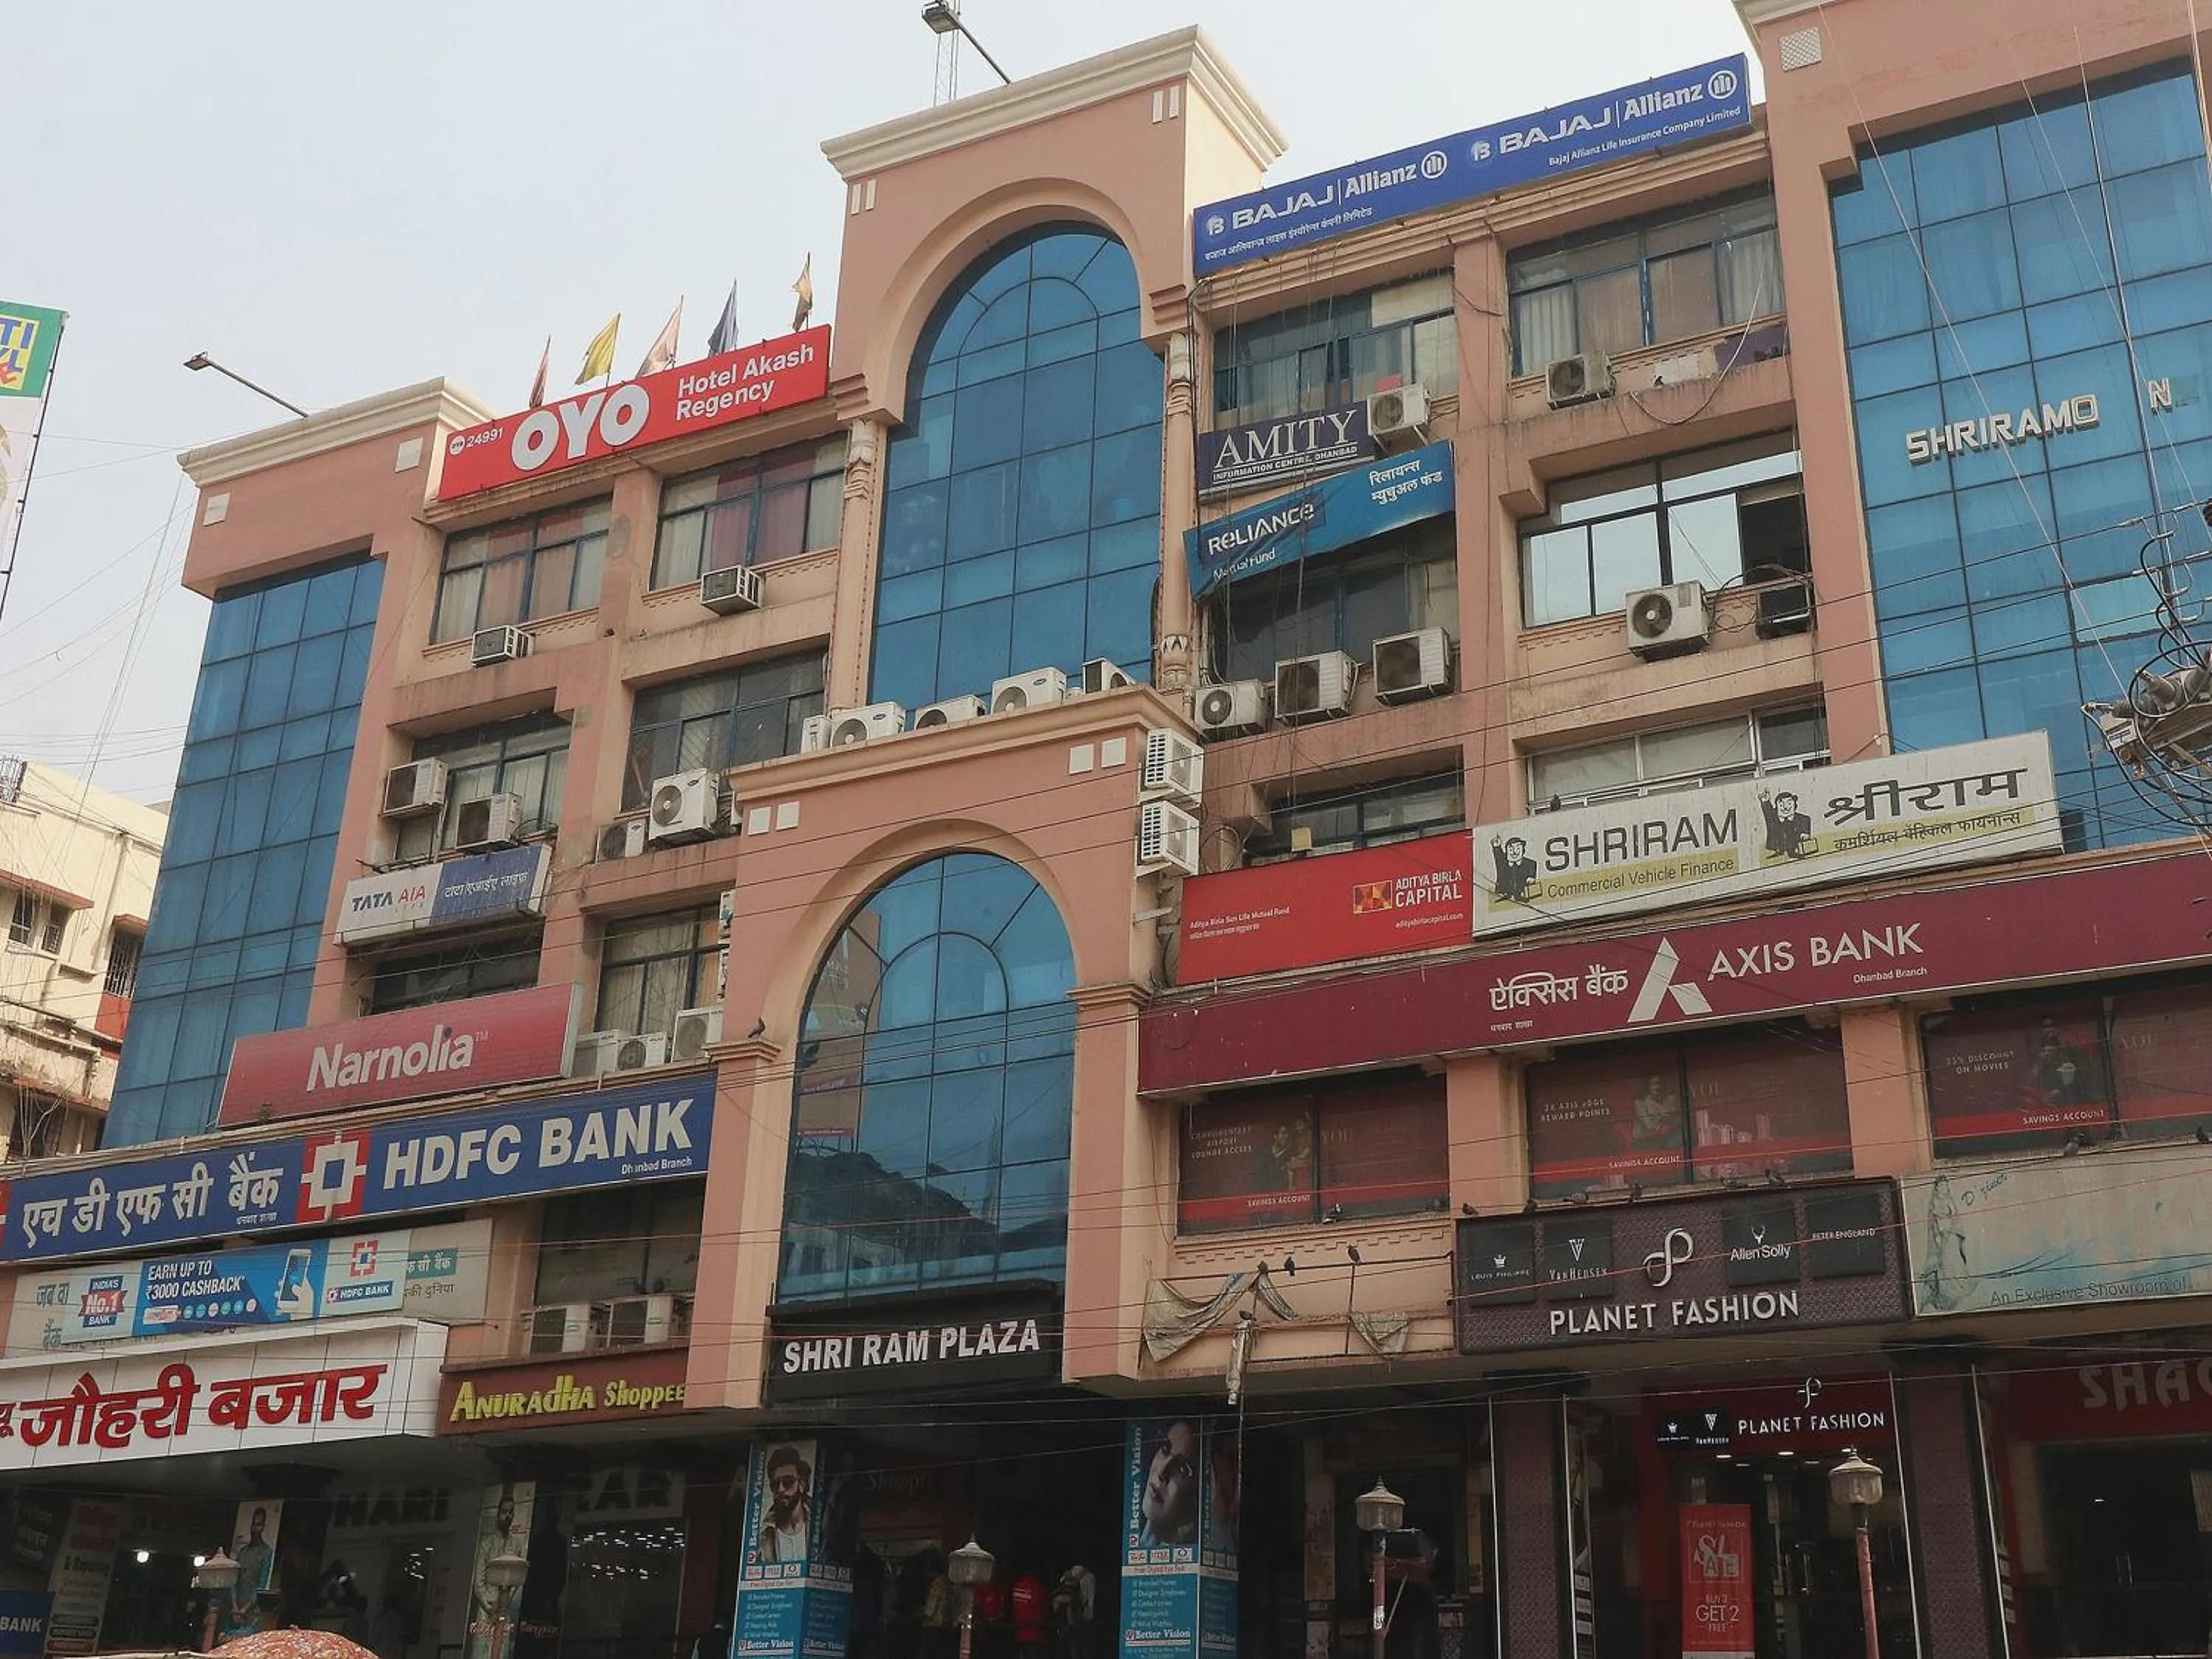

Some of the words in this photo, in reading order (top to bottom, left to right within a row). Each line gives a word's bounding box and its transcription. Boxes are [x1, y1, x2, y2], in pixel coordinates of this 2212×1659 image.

[1499, 107, 1611, 154] BAJAJ
[1624, 83, 1704, 121] Allianz
[1549, 152, 1571, 166] Bajaj
[1571, 146, 1601, 161] Allianz
[1601, 141, 1617, 152] Life
[1618, 131, 1662, 147] Insurance
[1663, 119, 1706, 136] Company
[1706, 106, 1741, 123] Limited
[1232, 185, 1334, 229] BAJAJ
[1344, 163, 1416, 199] Allianz
[678, 365, 737, 399] Hotel
[742, 343, 814, 380] Akash
[675, 378, 775, 422] Regency
[466, 428, 504, 448] 24991
[511, 384, 651, 472] OYO
[1214, 409, 1357, 469] AMITY
[1214, 463, 1273, 481] INFORMATION
[1315, 446, 1357, 461] DHANBAD
[1369, 459, 1420, 487] रिलायन्स
[1249, 546, 1276, 568] Fund
[1823, 767, 2028, 826] श्रीराम
[1545, 809, 1738, 872] SHRIRAM
[1396, 874, 1430, 891] ADITYA
[1432, 869, 1462, 884] BIRLA
[1548, 873, 1624, 898] Commercial
[1628, 867, 1676, 886] Vehicle
[1680, 859, 1734, 877] Finance
[352, 891, 393, 912] TATA
[398, 886, 425, 904] AIA
[1396, 883, 1463, 908] CAPITAL
[1707, 941, 1795, 982] AXIS
[1809, 922, 1924, 967] BANK
[1585, 964, 1629, 996] बैंक
[1853, 970, 1893, 984] Dhanbad
[1896, 965, 1928, 978] Branch
[307, 1024, 474, 1093] Narnolia
[2023, 1114, 2059, 1125] SAVINGS
[2062, 1110, 2104, 1121] ACCOUNT
[383, 1124, 521, 1190] HDFC
[538, 1098, 694, 1169] BANK
[622, 1160, 659, 1175] Dhanbad
[661, 1155, 692, 1170] Branch
[1644, 1155, 1681, 1166] ACCOUNT
[22, 1197, 67, 1251] एच
[72, 1177, 111, 1233] डी
[116, 1183, 166, 1237] एफ
[173, 1161, 215, 1220] सी
[228, 1150, 284, 1211] बैंक
[1277, 1194, 1311, 1205] ACCOUNT
[1731, 1246, 1760, 1261] Allen
[1761, 1243, 1792, 1259] Solly
[147, 1262, 178, 1280] EARN
[180, 1262, 195, 1277] UP
[198, 1260, 212, 1276] TO
[1471, 1273, 1493, 1281] LOUIS
[86, 1290, 120, 1315] No.1
[145, 1282, 179, 1300] ₹3000
[340, 1287, 363, 1298] HDFC
[365, 1284, 390, 1295] BANK
[1991, 1290, 2010, 1305] An
[2016, 1286, 2084, 1303] Exclusive
[2088, 1280, 2170, 1298] Showroom
[88, 1315, 111, 1326] BANK
[1551, 1302, 1657, 1336] PLANET
[1672, 1290, 1799, 1326] FASHION
[784, 1337, 853, 1374] SHRI
[862, 1329, 928, 1366] RAM
[939, 1318, 1040, 1360] PLAZA
[19, 1363, 201, 1449] जौहरी
[207, 1363, 388, 1430] बजार
[1738, 1416, 1801, 1435] PLANET
[1810, 1411, 1885, 1431] FASHION
[1131, 1427, 1142, 1477] Vision
[1130, 1481, 1142, 1530] Better
[1696, 1604, 1726, 1622] GET
[1729, 1604, 1740, 1621] 2
[771, 1638, 794, 1649] Vision
[1135, 1630, 1161, 1639] Better
[1163, 1628, 1191, 1638] Vision
